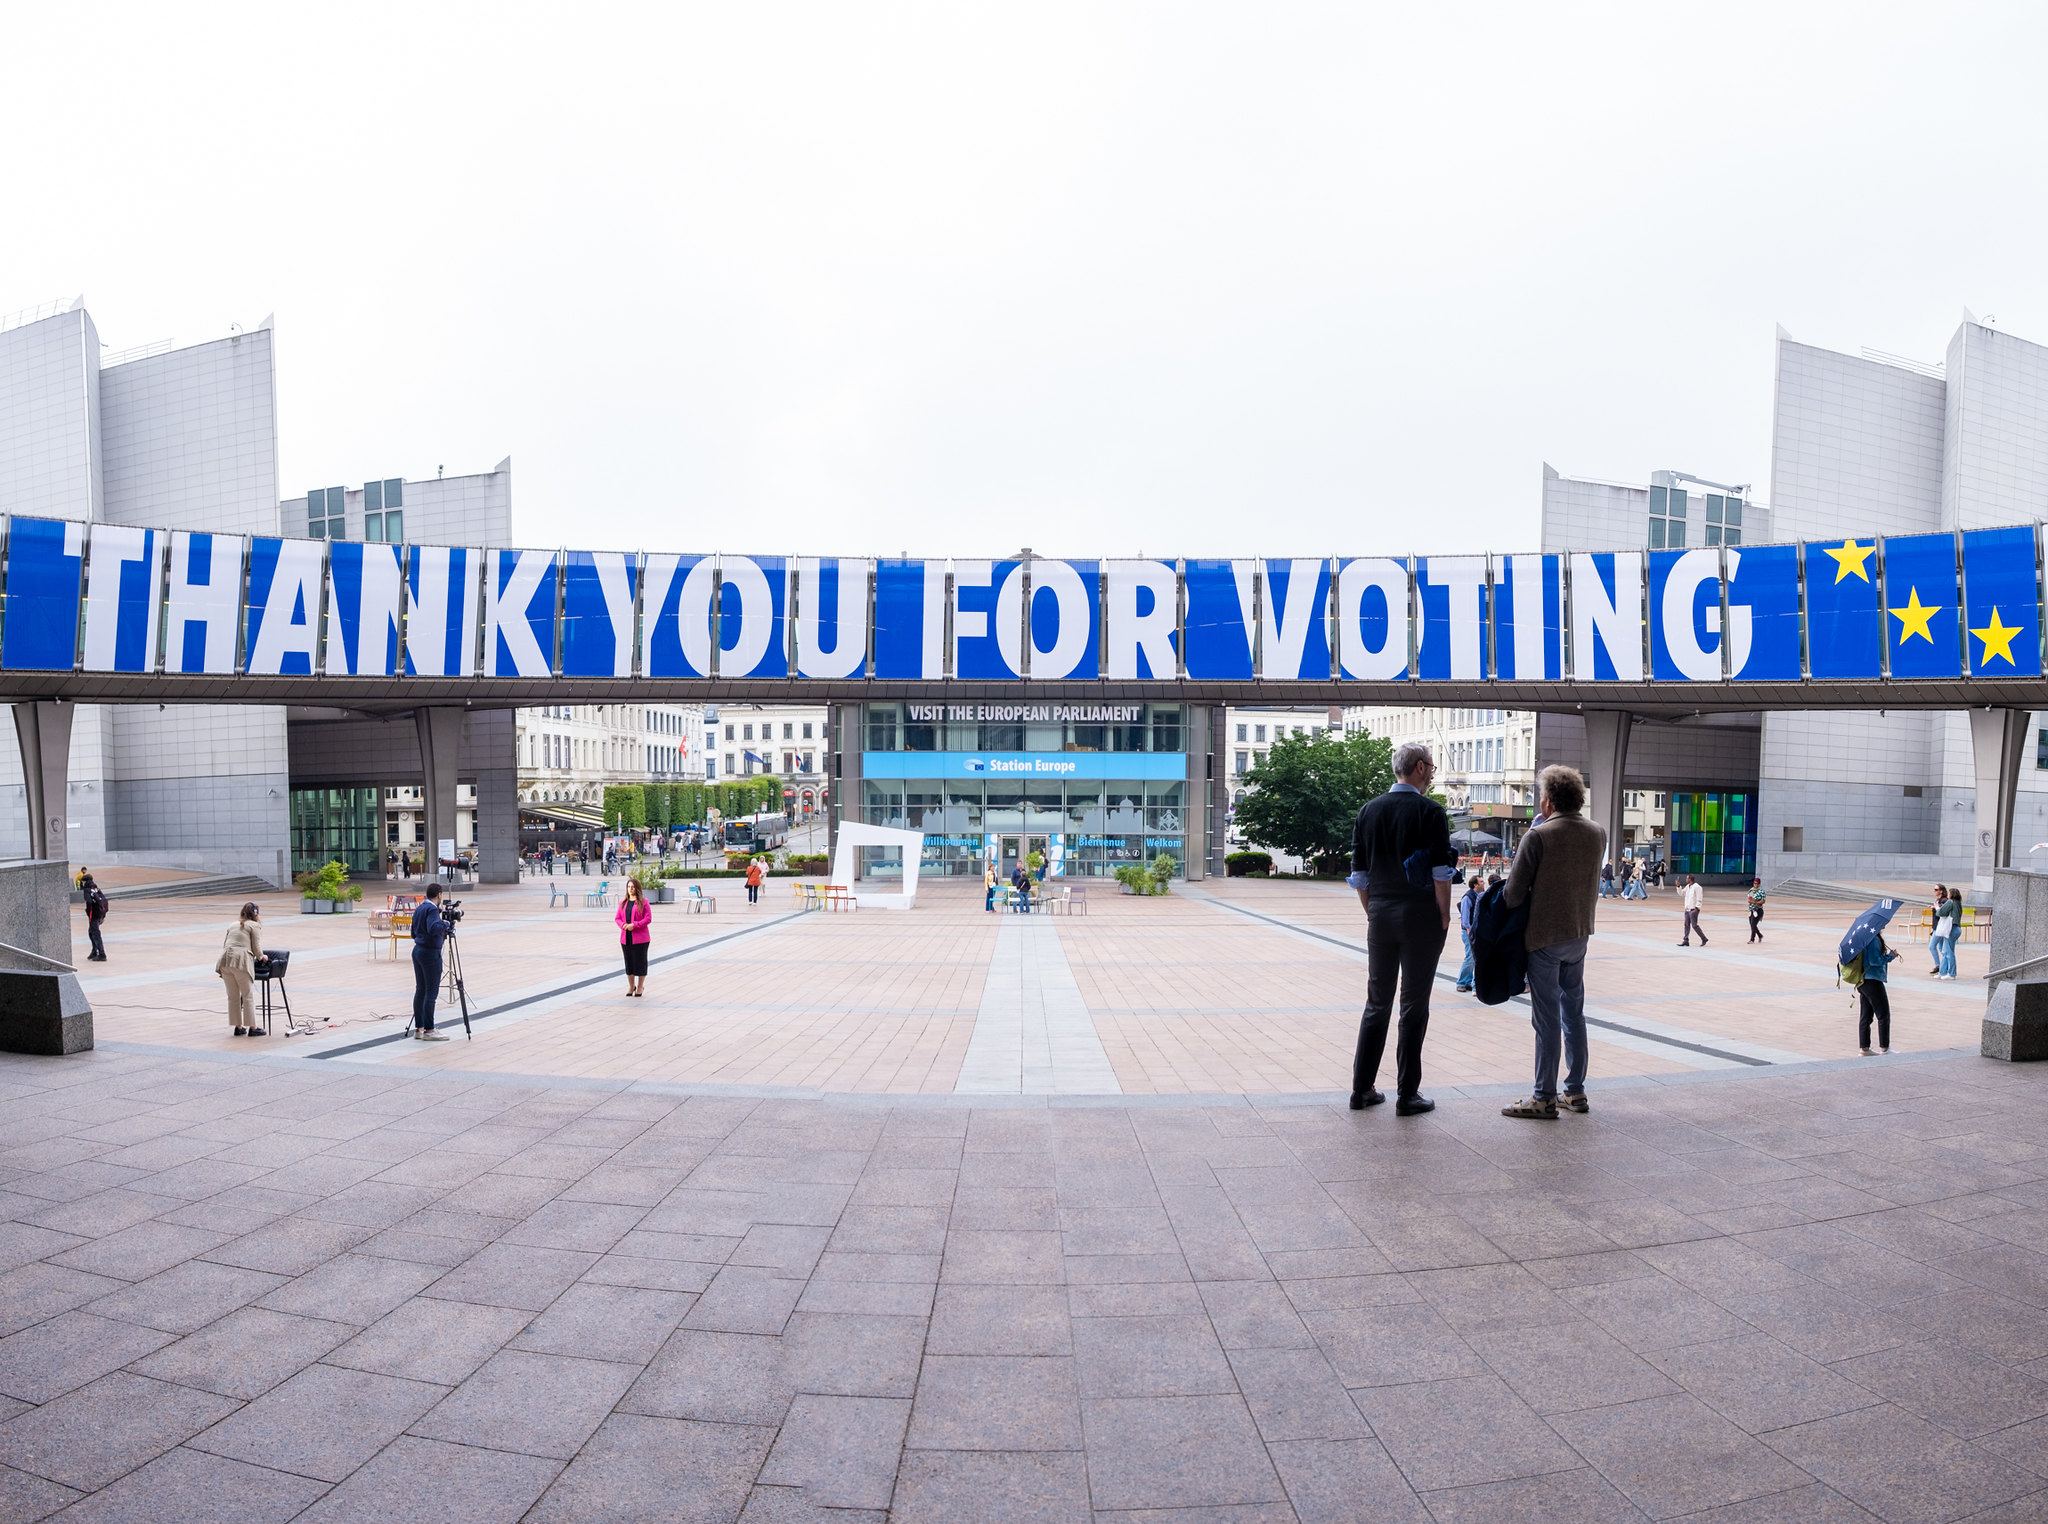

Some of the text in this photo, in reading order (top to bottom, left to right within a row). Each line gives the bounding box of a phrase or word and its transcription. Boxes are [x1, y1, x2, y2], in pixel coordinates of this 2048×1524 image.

[63, 521, 1753, 681] THANK YOU FOR VOTING
[910, 705, 1140, 721] VISIT THE EUROPEAN PARLIAMENT
[990, 759, 1076, 775] Station Europe
[923, 836, 979, 846] Willkommen
[1078, 836, 1126, 847] Bienvenue
[1146, 837, 1182, 848] Welkom
